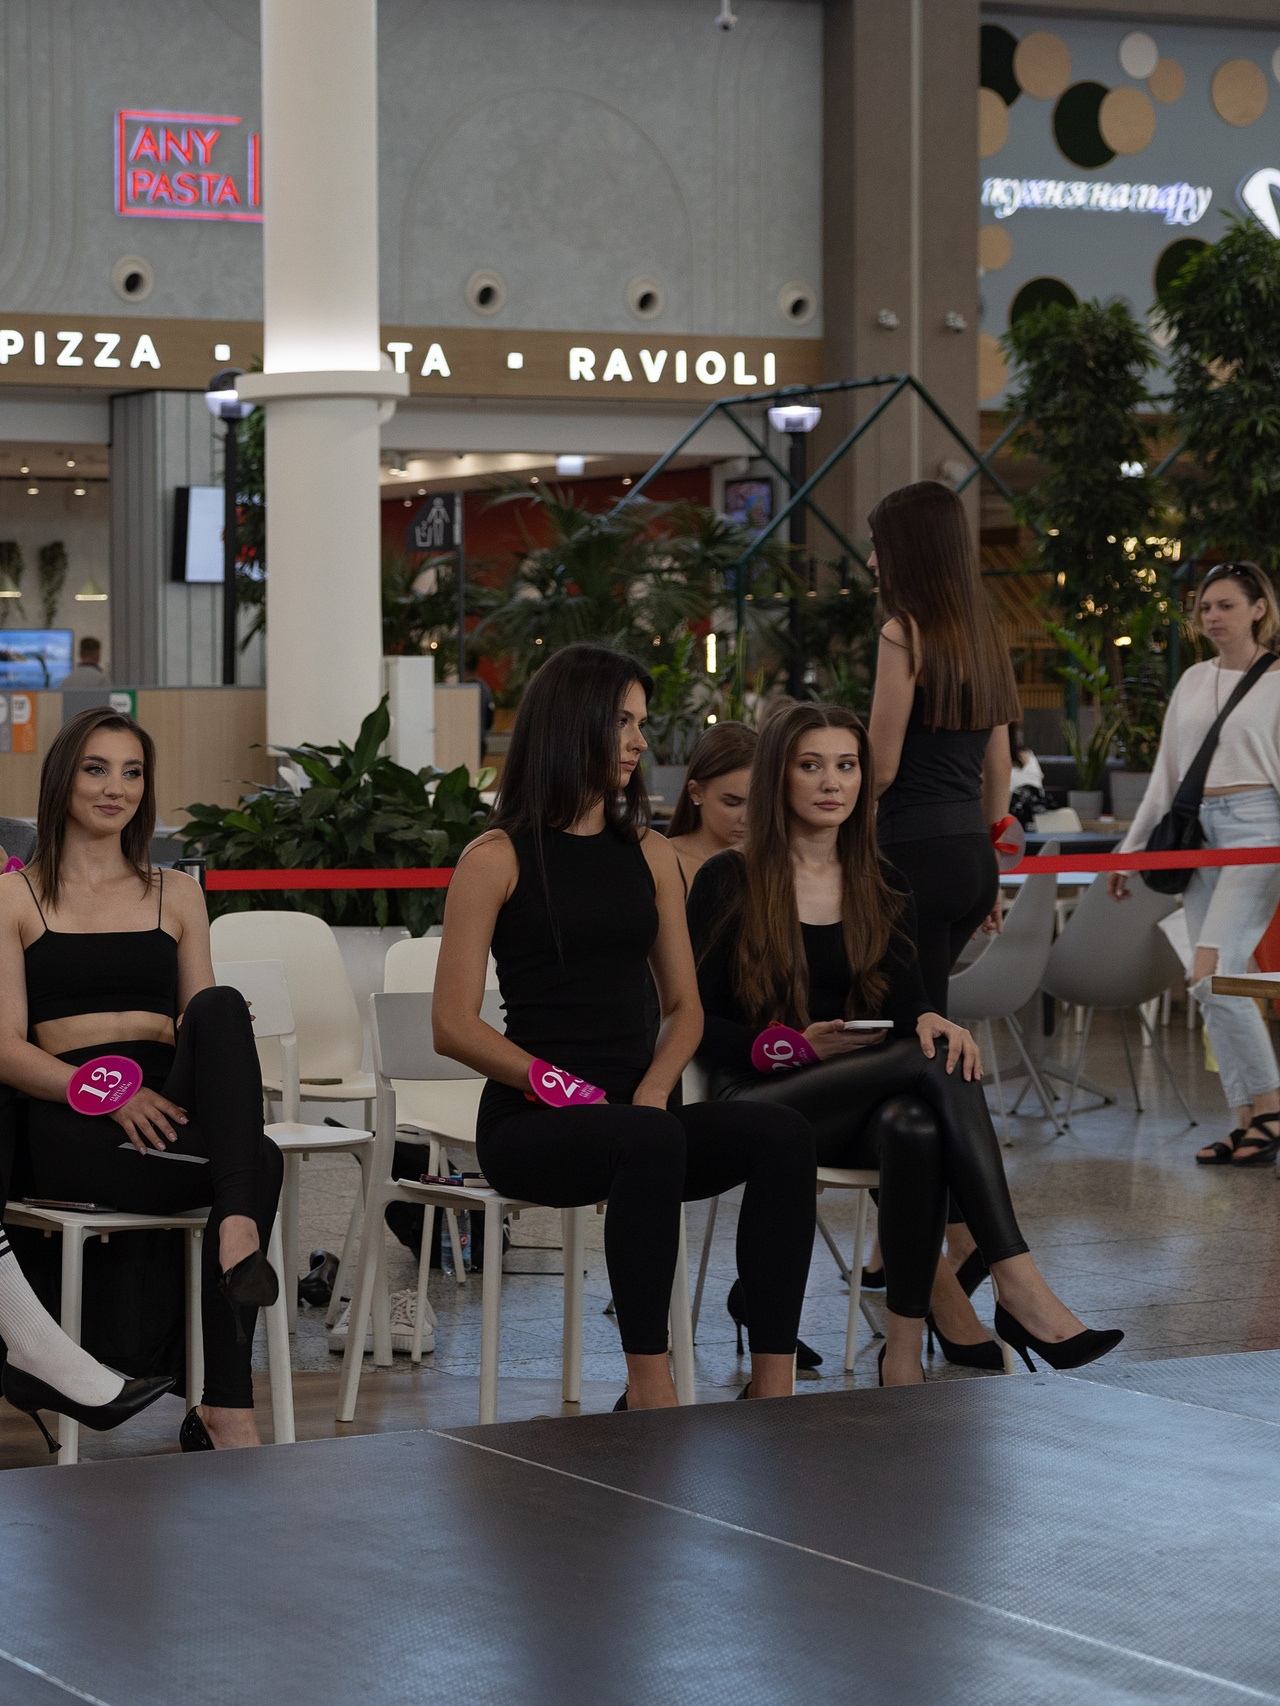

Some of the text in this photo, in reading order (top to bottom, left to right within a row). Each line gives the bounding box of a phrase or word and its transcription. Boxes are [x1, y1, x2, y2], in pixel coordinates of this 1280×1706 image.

[130, 126, 220, 165] ANY
[129, 170, 240, 206] PASTA
[570, 347, 776, 386] RAVIOLI
[78, 1067, 122, 1103] 13
[542, 1065, 584, 1099] 2
